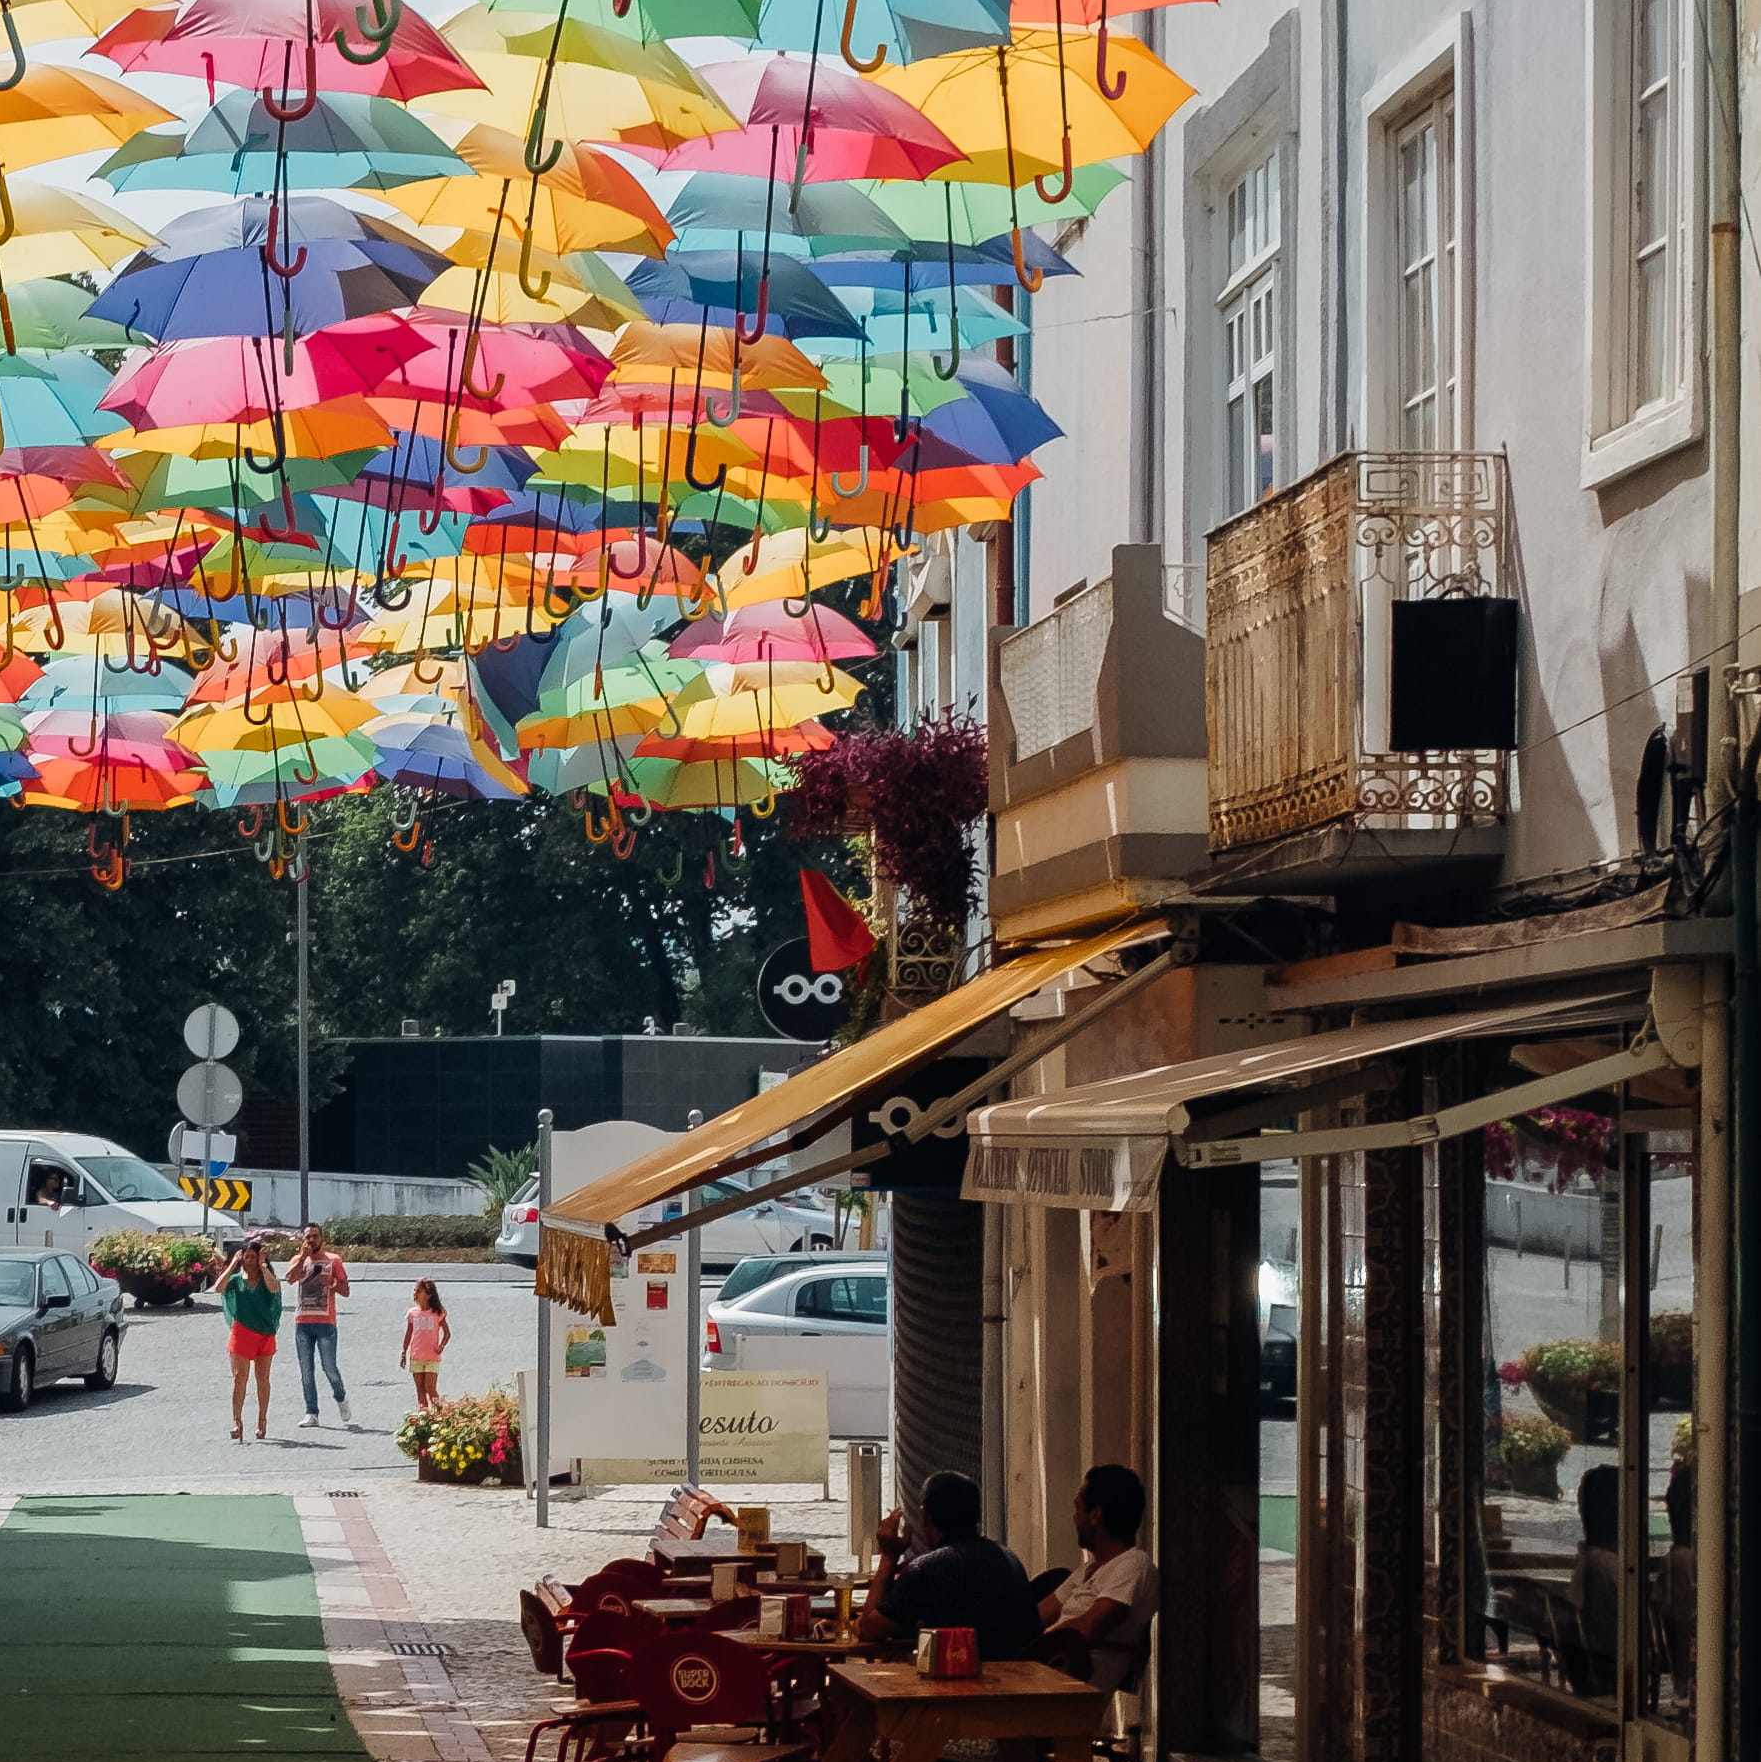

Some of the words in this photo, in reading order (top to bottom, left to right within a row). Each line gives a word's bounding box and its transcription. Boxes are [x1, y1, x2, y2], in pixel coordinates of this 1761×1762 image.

[699, 1410, 780, 1435] esuto
[678, 1669, 709, 1680] SUPER
[681, 1679, 710, 1688] BOCK
